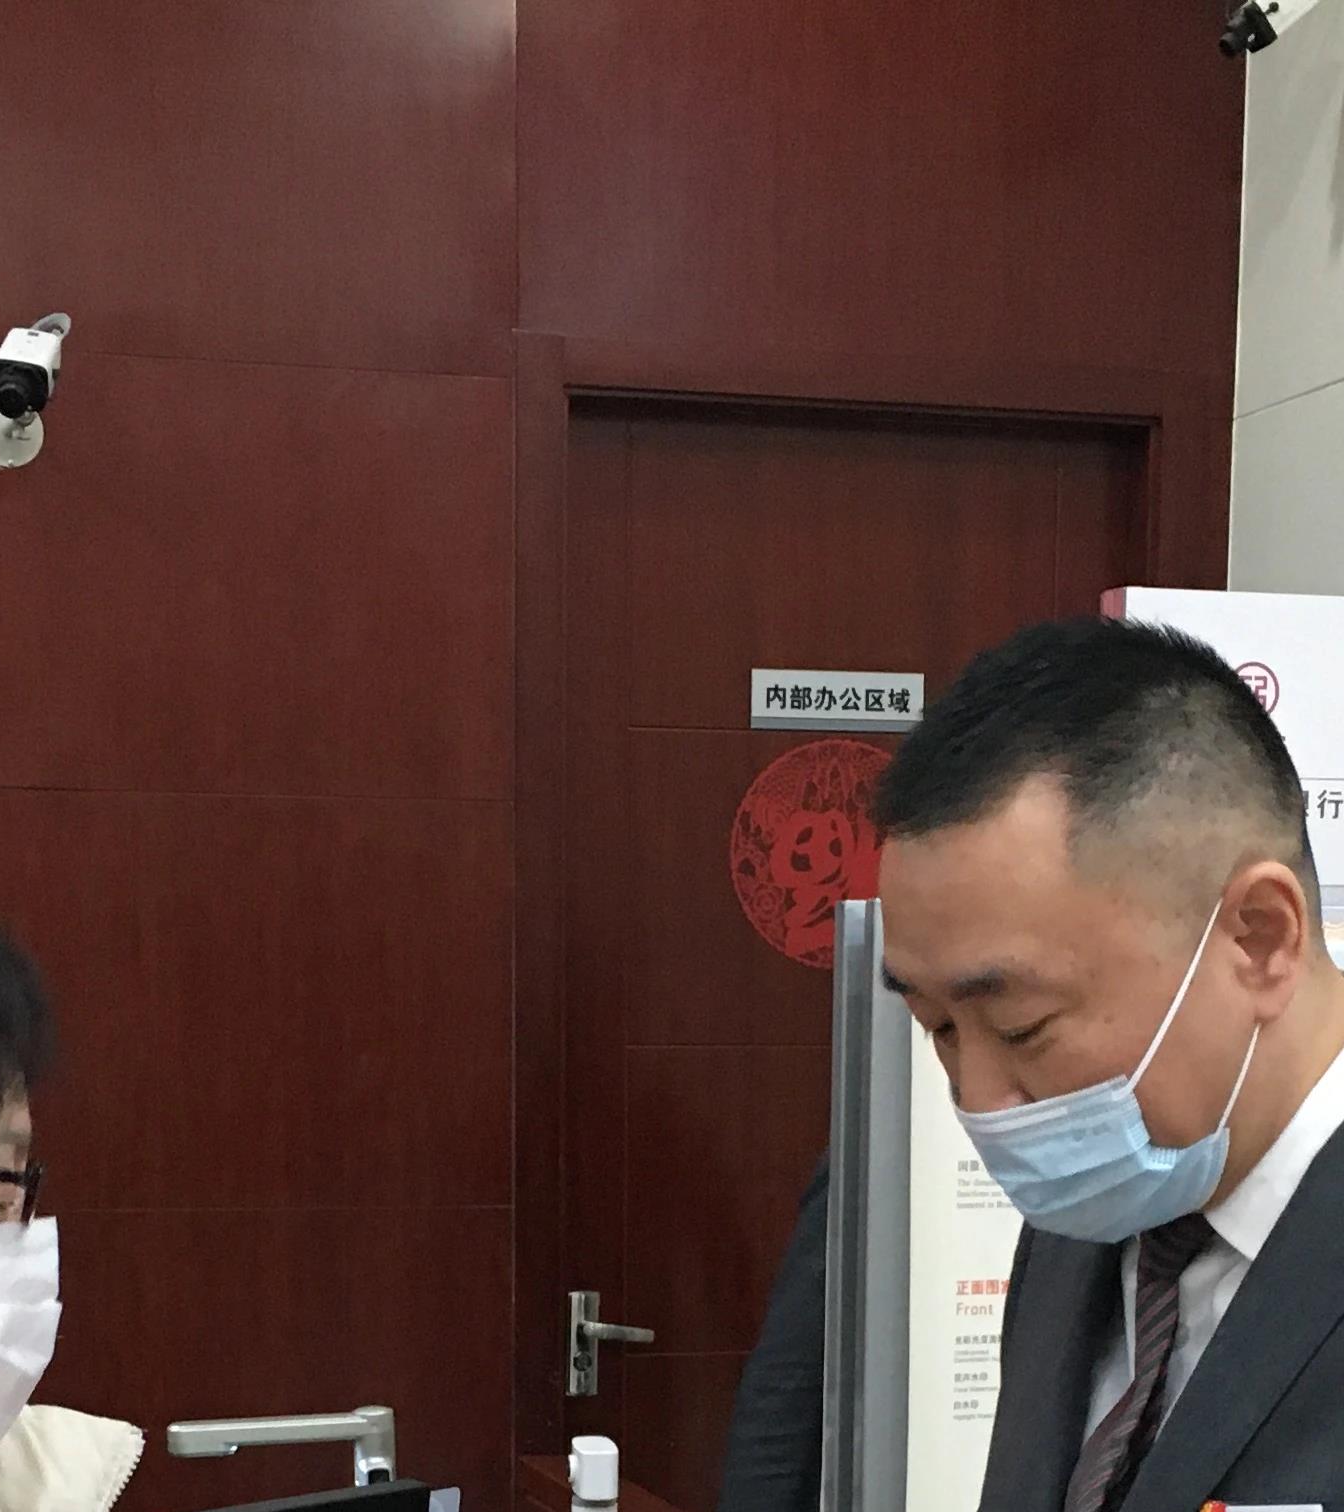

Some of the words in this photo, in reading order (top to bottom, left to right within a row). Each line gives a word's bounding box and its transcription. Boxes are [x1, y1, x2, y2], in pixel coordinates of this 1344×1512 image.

[765, 684, 911, 714] 内部办公区域
[955, 1302, 994, 1316] Front
